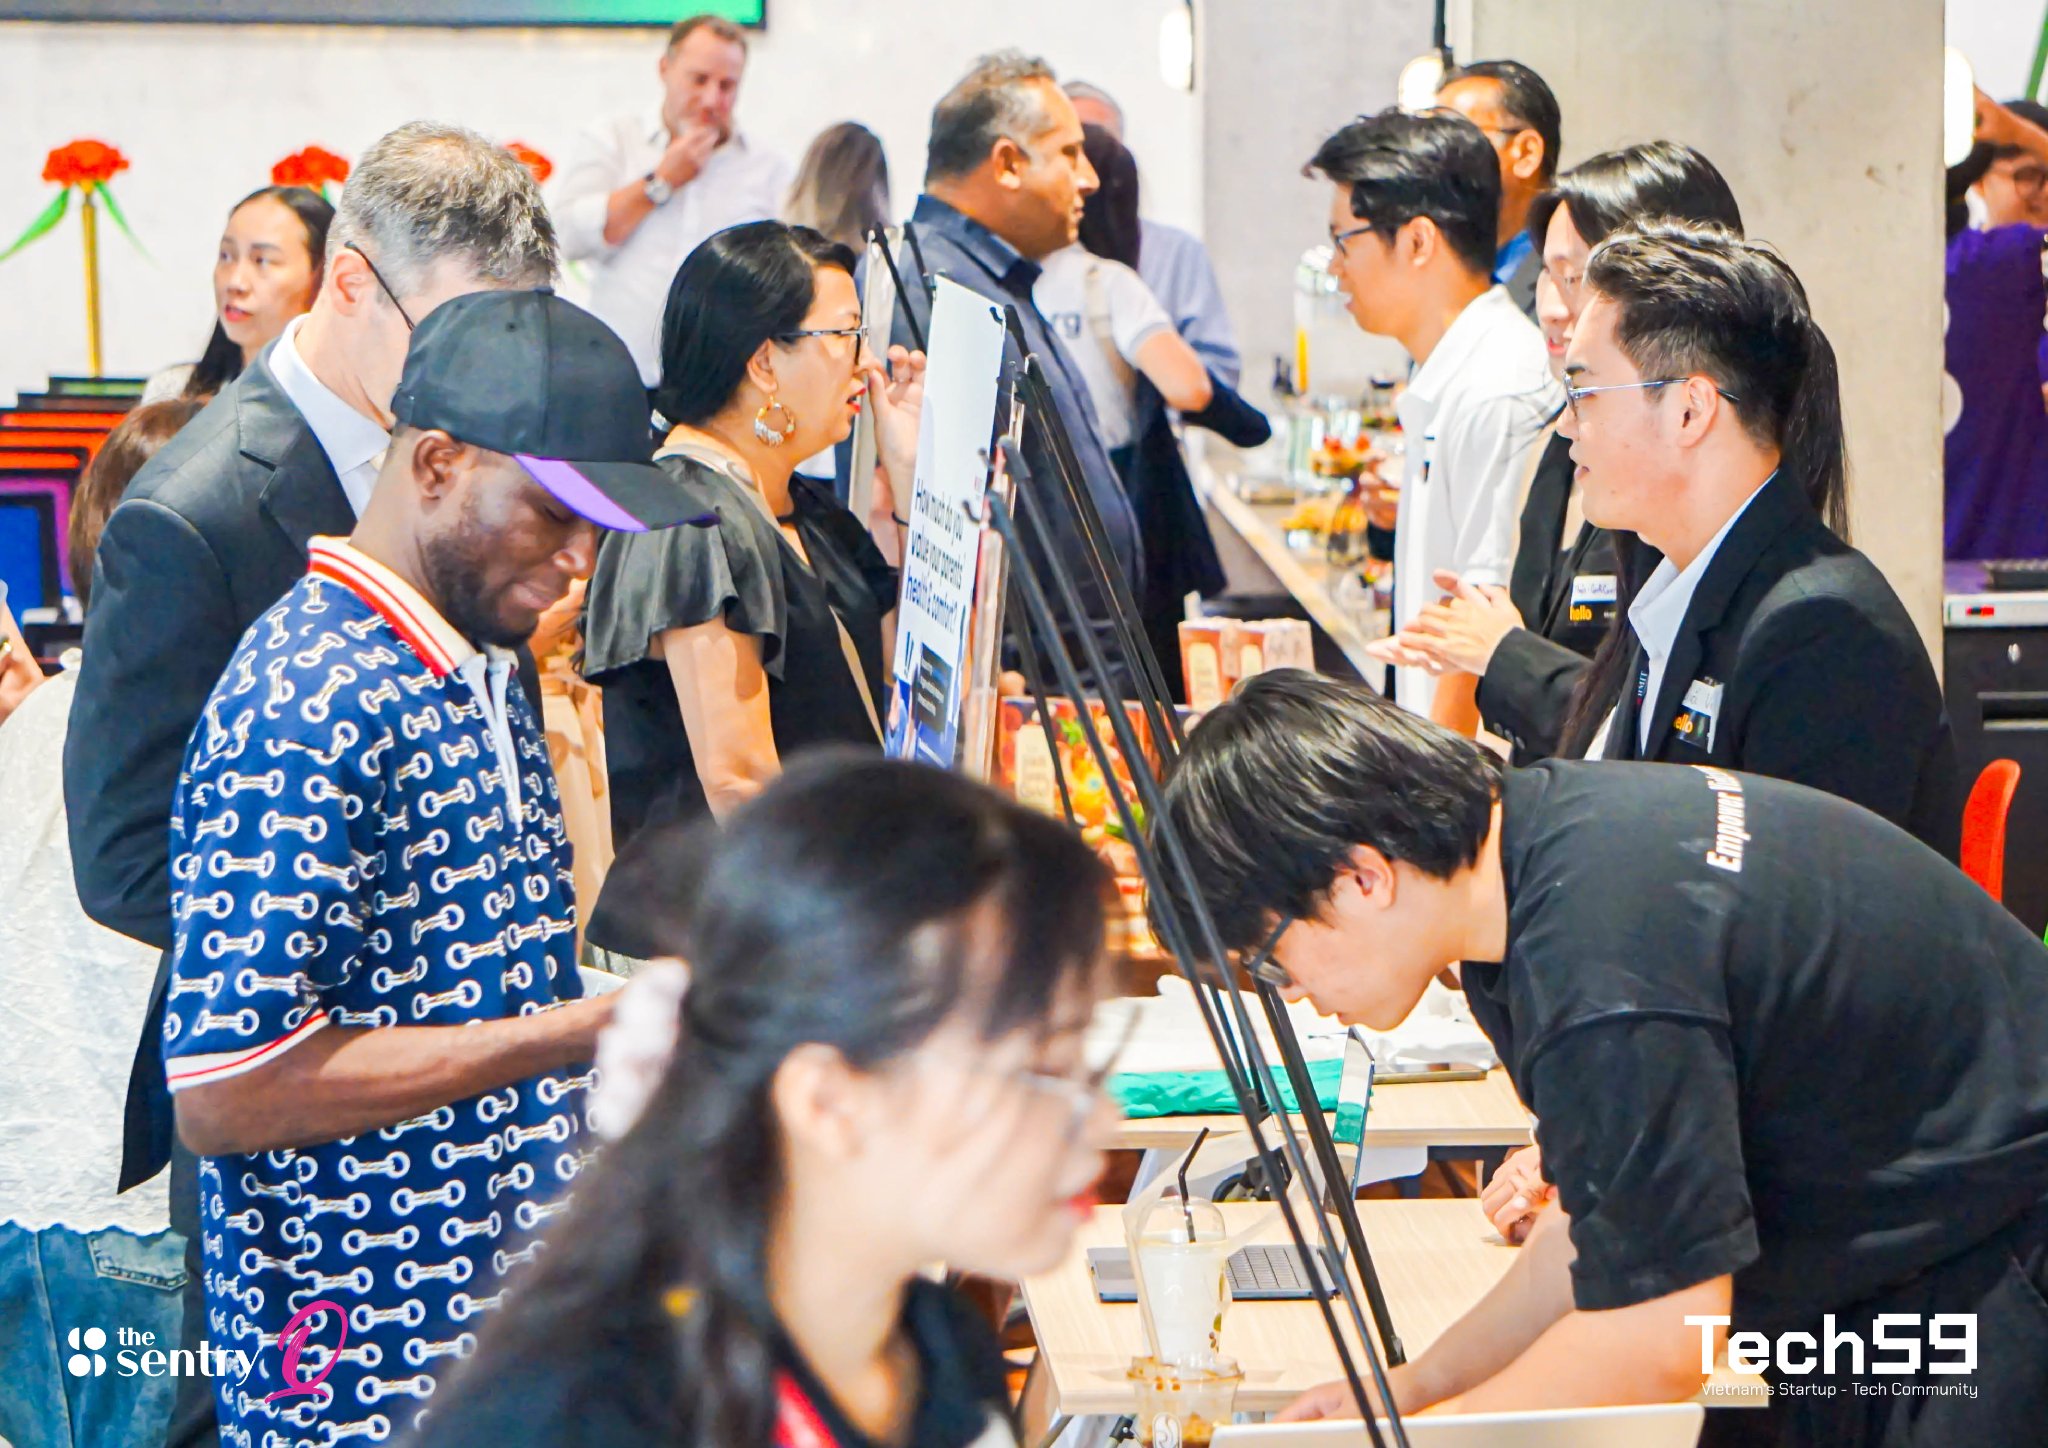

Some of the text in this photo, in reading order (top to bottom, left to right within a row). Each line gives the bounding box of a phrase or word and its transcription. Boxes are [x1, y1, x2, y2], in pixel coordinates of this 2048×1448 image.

[915, 477, 930, 517] How
[930, 491, 946, 528] much
[952, 509, 964, 546] you
[911, 524, 930, 565] value
[927, 542, 942, 577] your
[1569, 605, 1592, 621] hello
[1706, 791, 1752, 873] Empower
